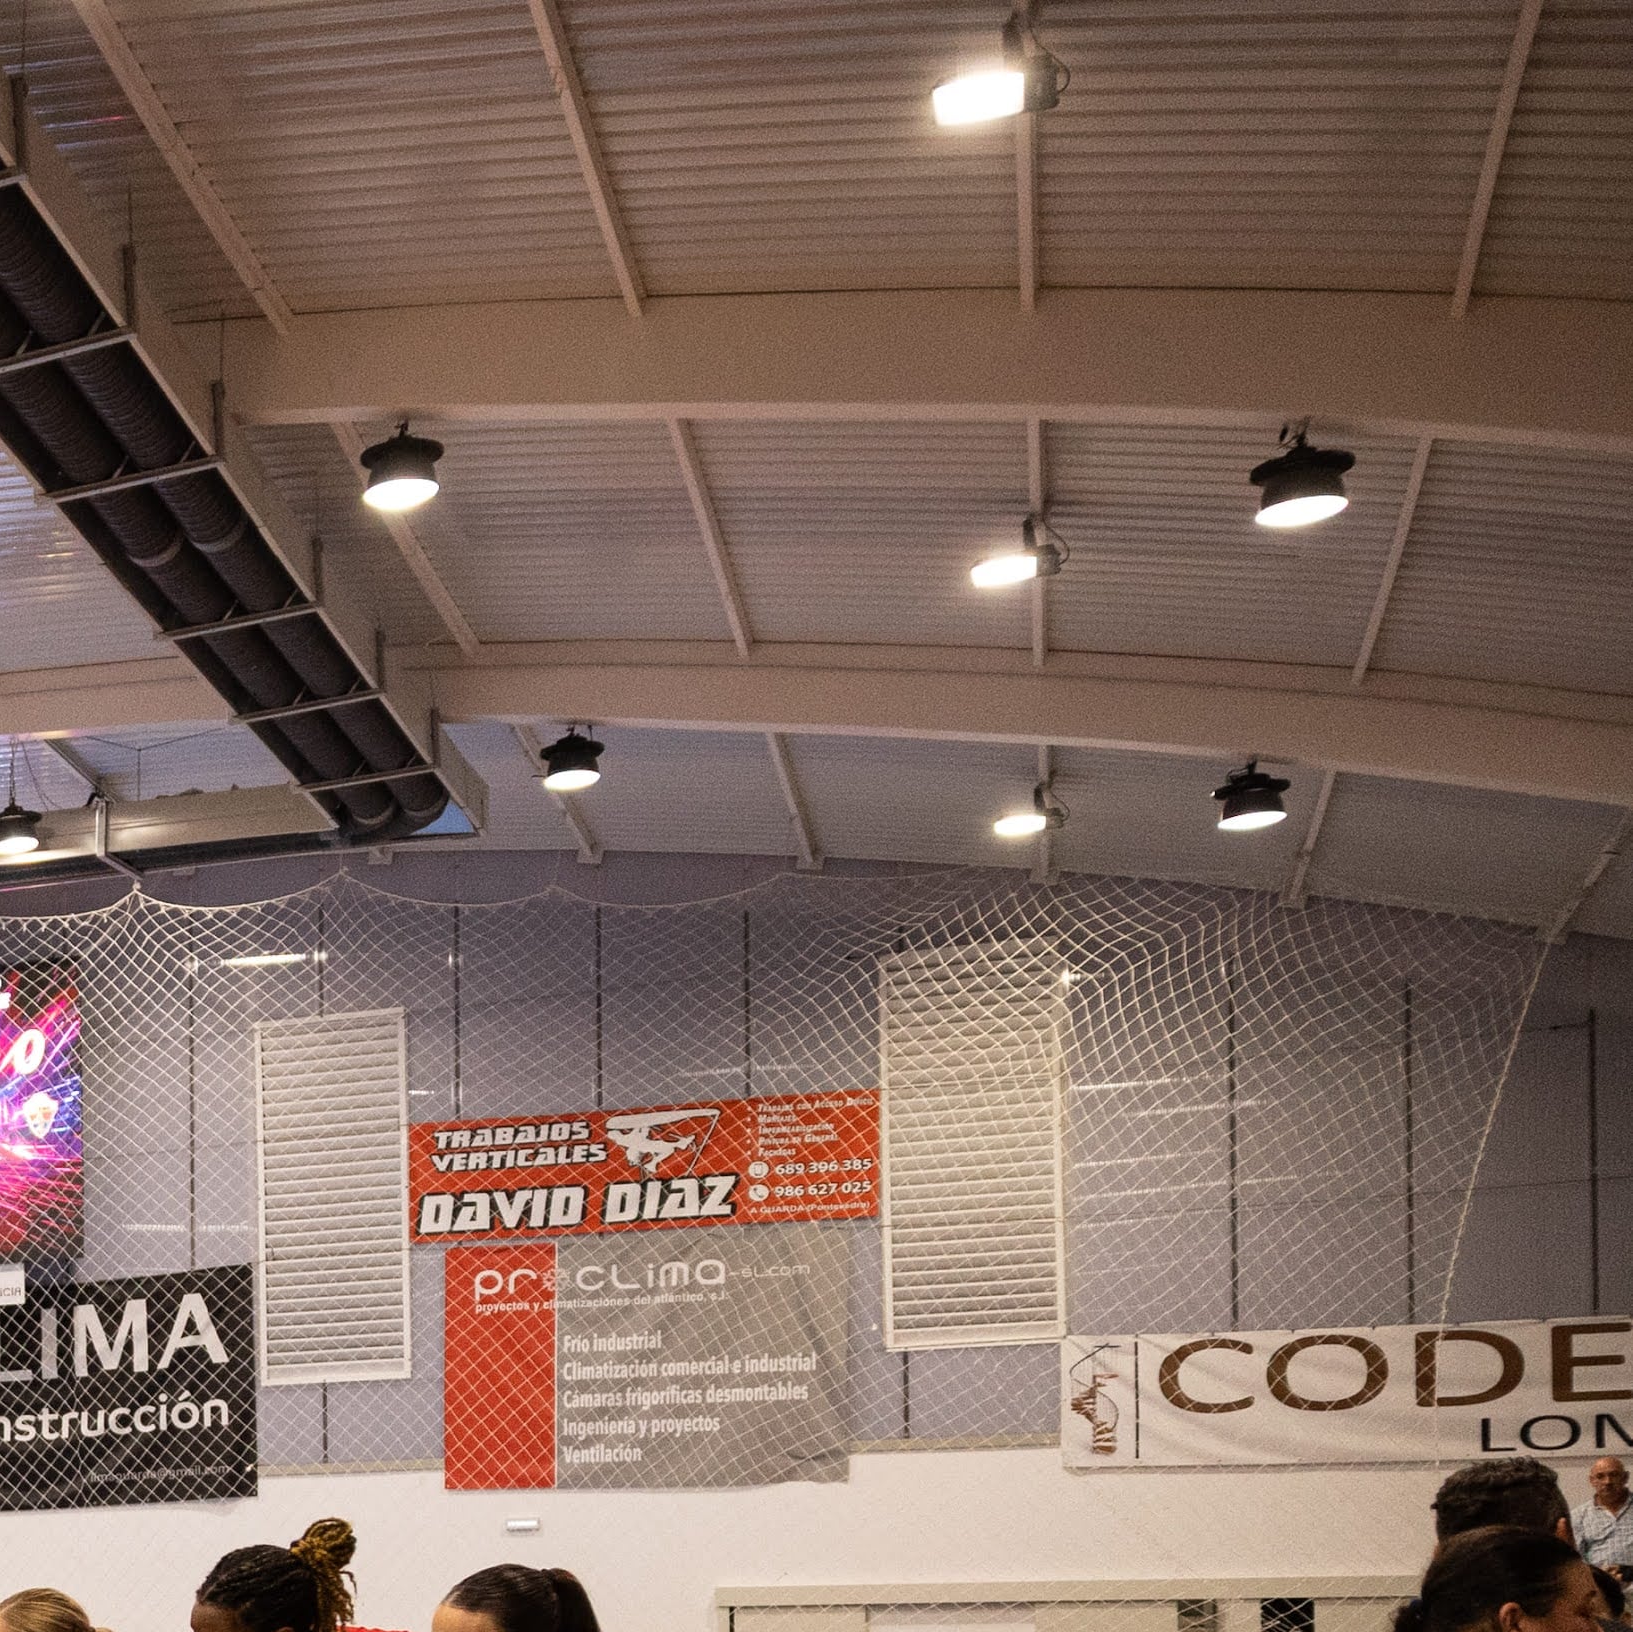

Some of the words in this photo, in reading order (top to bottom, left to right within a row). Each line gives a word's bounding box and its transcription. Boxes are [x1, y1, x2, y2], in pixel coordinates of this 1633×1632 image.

[12, 1028, 46, 1075] 0
[433, 1121, 590, 1150] TRABAJOS
[431, 1143, 608, 1173] VERTICALES
[774, 1163, 806, 1175] 689
[808, 1161, 839, 1174] 396
[842, 1158, 872, 1170] 385
[773, 1185, 805, 1197] 986
[807, 1183, 838, 1195] 627
[841, 1181, 872, 1194] 025
[419, 1186, 585, 1235] DAVID
[604, 1175, 737, 1224] DIAZ
[759, 1204, 806, 1214] GUARDA
[475, 1301, 531, 1316] proyectos
[533, 1303, 541, 1315] y
[592, 1330, 662, 1352] industrial
[563, 1360, 658, 1381] Climatización
[661, 1355, 730, 1378] comercial
[733, 1359, 741, 1374] e
[744, 1351, 817, 1373] industrial
[706, 1381, 809, 1403] desmontables
[639, 1420, 649, 1439] y
[651, 1414, 721, 1438] proyectos
[563, 1443, 643, 1464] Ventilación
